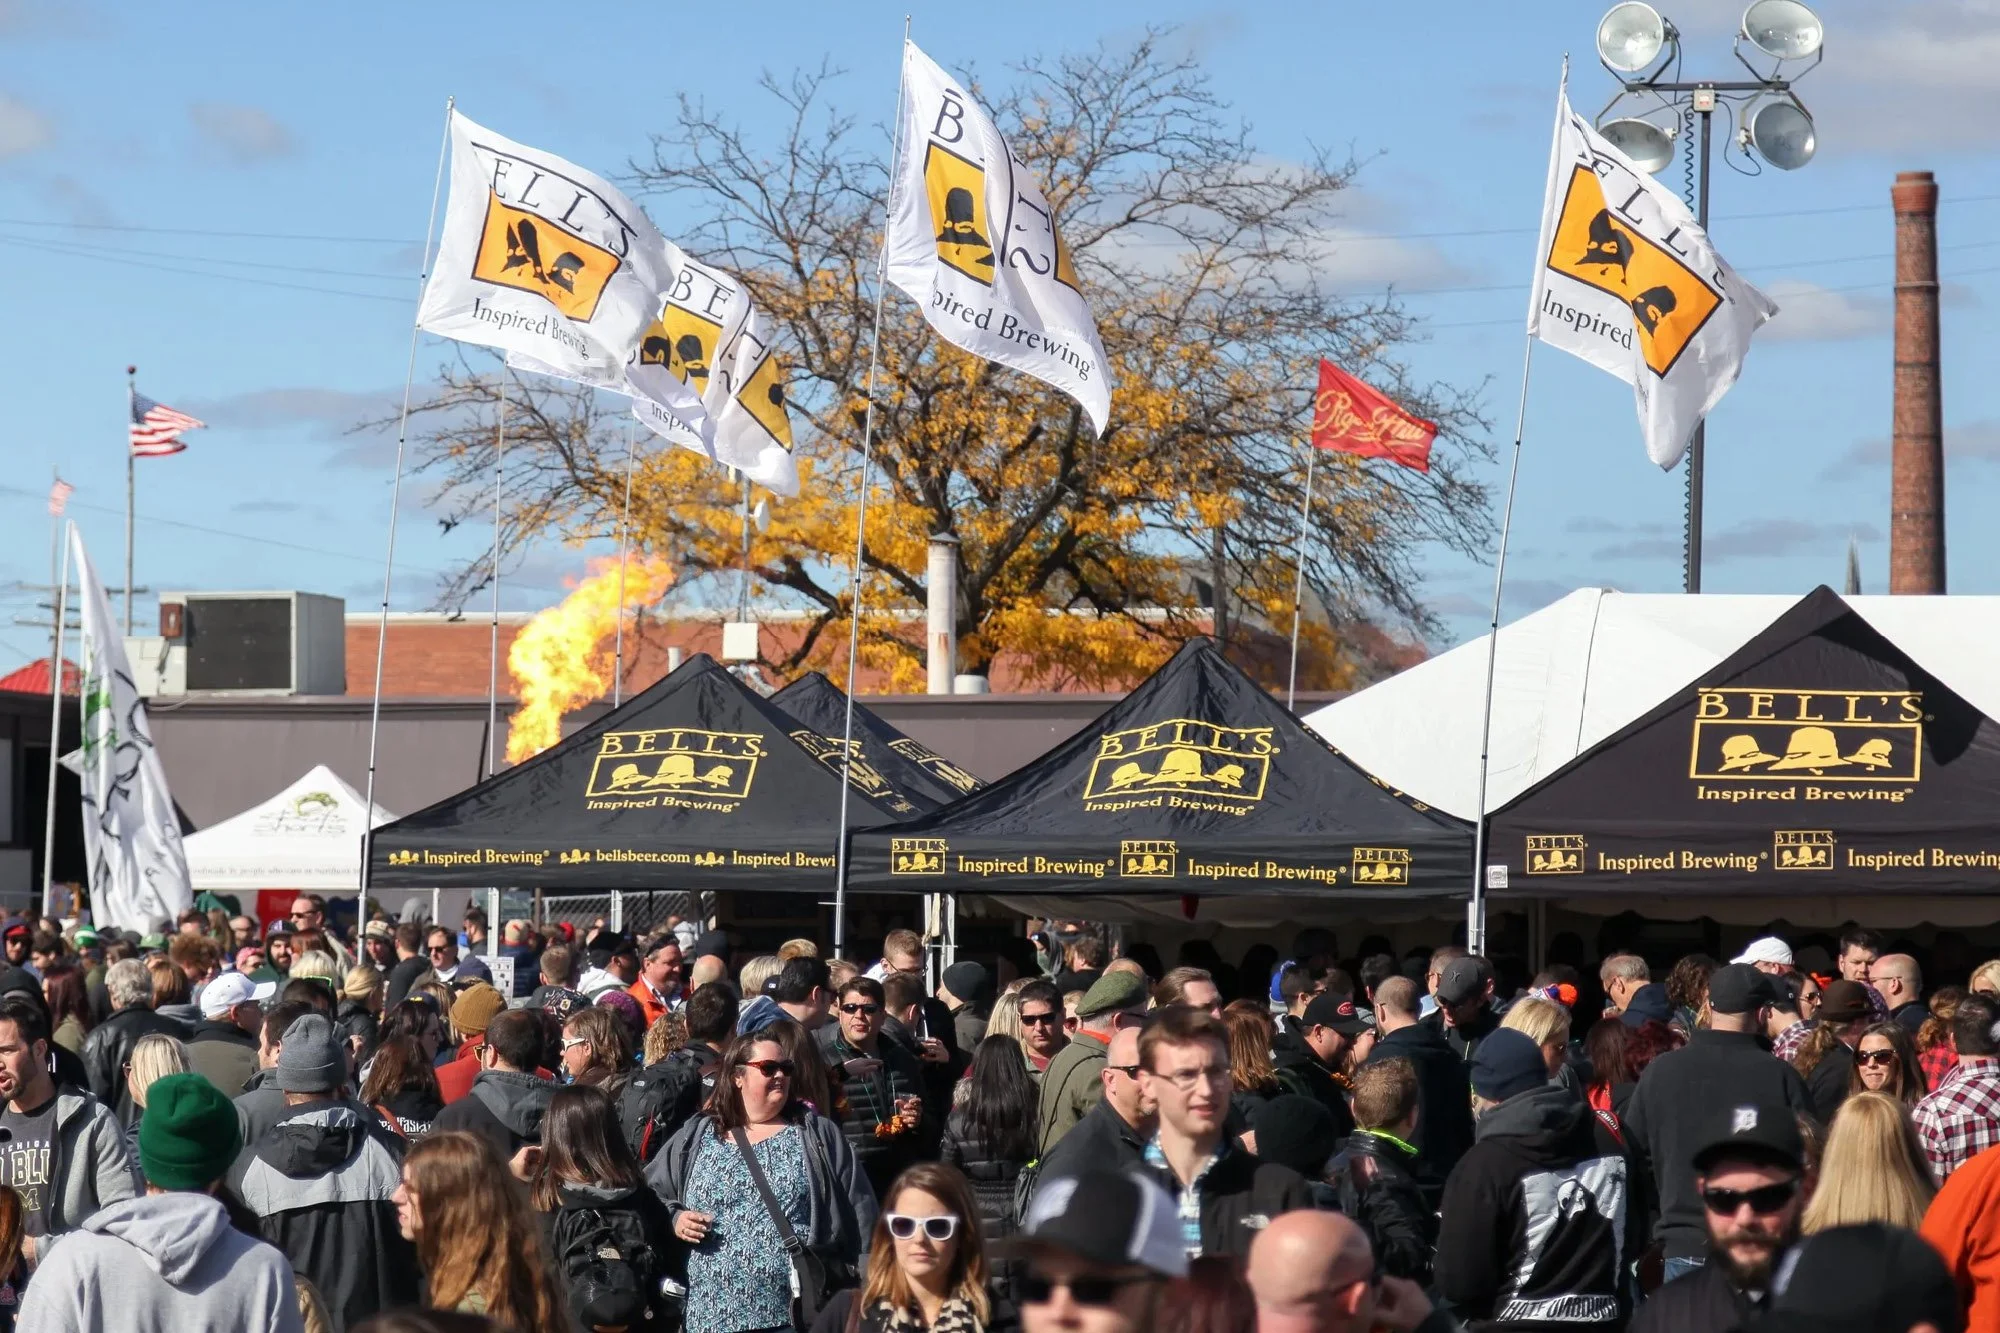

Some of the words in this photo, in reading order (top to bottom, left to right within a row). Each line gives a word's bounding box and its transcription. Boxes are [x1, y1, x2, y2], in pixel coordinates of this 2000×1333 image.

[494, 158, 630, 259] ELL'S
[472, 297, 549, 335] Inspired
[1542, 289, 1632, 350] Inspired
[932, 289, 994, 332] pired
[998, 313, 1091, 381] Brewing
[1694, 693, 1923, 723] BELL'S
[600, 736, 763, 757] BELL'S
[1097, 723, 1273, 755] BELL'S
[586, 797, 657, 812] Inspired
[1084, 796, 1163, 813] Inspired
[1697, 785, 1797, 803] Inspired
[424, 849, 482, 866] Inspired
[596, 849, 690, 864] bellsbeer.com
[733, 850, 791, 869] Inspired
[795, 852, 836, 867] Brewi
[958, 855, 1028, 877] Inspired
[1599, 851, 1675, 874] Inspired
[1848, 848, 1926, 871] Inspired
[1932, 848, 2000, 868] Brewin
[1188, 858, 1260, 881] Inspired
[1, 1140, 50, 1155] ICHIGA
[11, 1148, 50, 1186] BLU
